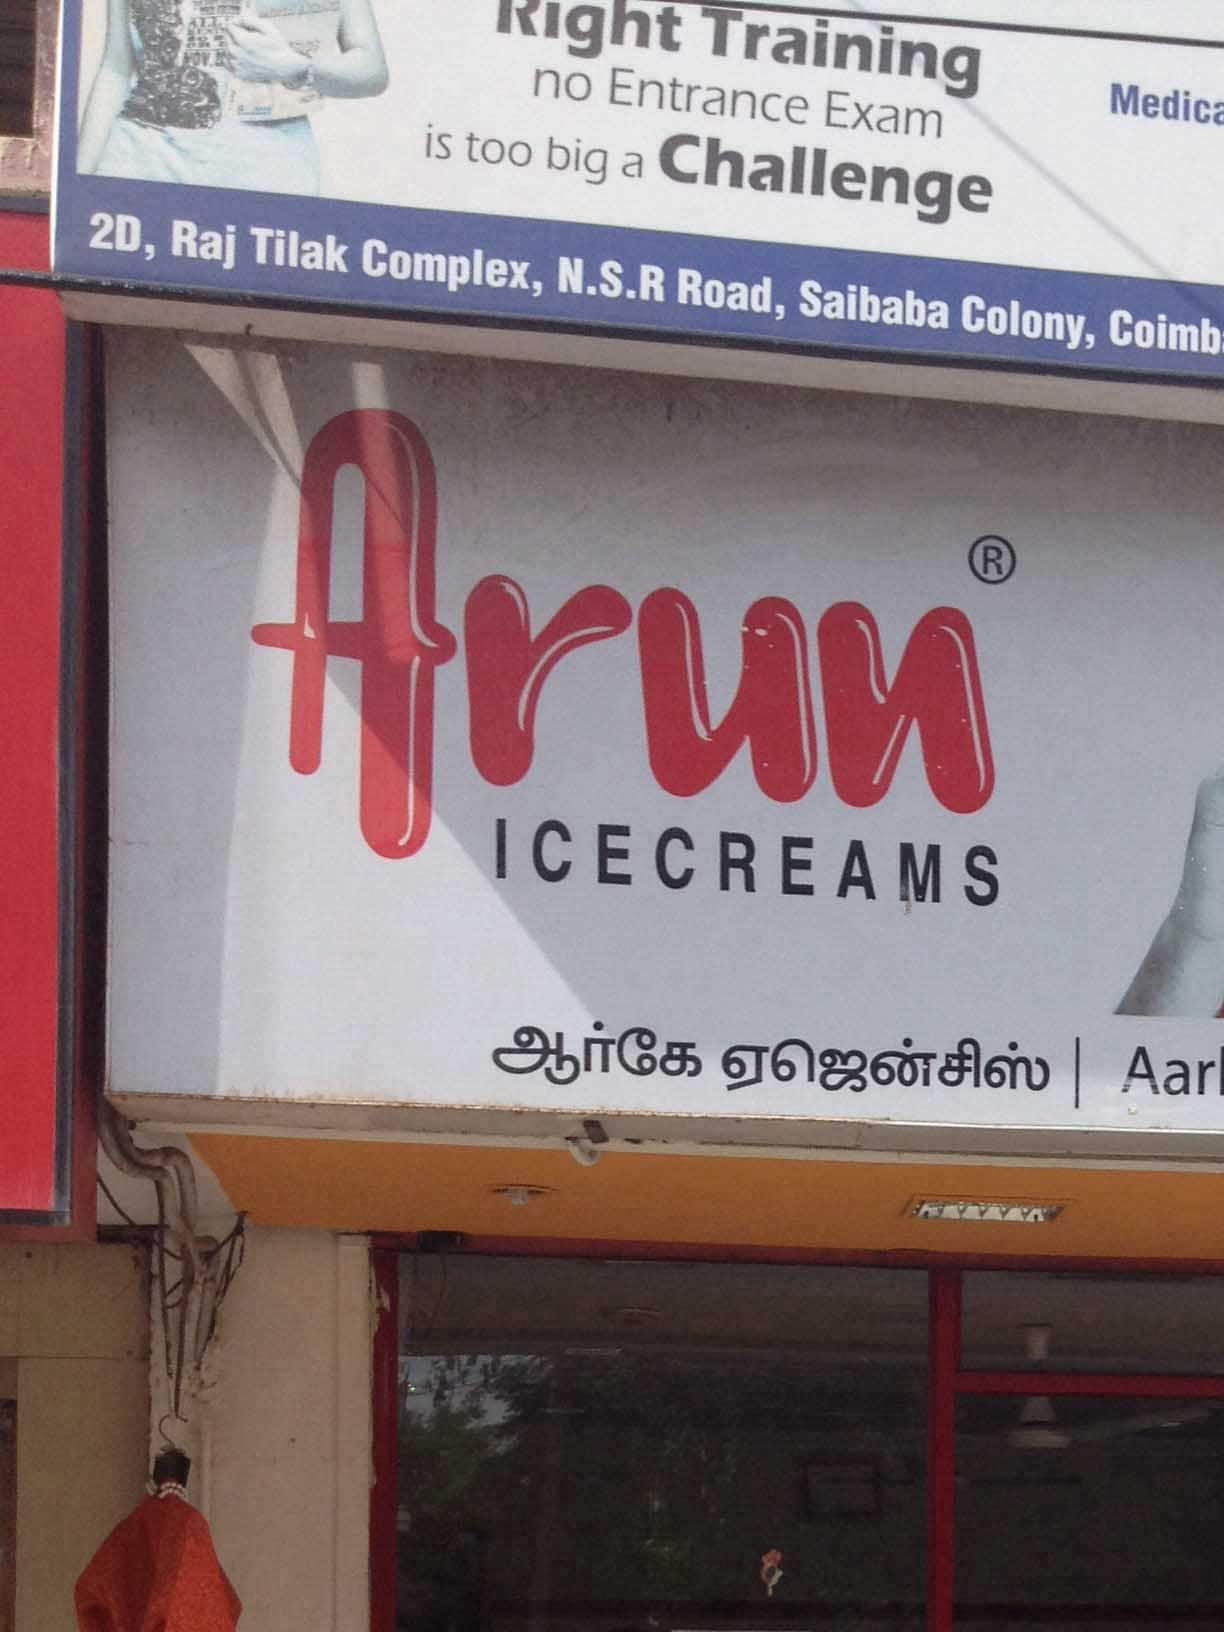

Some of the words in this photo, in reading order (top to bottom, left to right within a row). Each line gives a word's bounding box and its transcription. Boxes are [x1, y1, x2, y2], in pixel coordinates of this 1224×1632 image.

[497, 0, 682, 59] Right
[700, 7, 981, 98] Training
[533, 66, 591, 101] no
[609, 68, 808, 124] Entrance
[824, 91, 943, 138] Exam
[424, 123, 451, 160] is
[466, 130, 532, 167] too
[546, 137, 608, 184] big
[621, 149, 643, 178] a
[658, 133, 993, 225] Challenge
[89, 212, 156, 262] 2D,
[171, 219, 236, 270] Raj
[251, 226, 348, 274] Tilak
[362, 238, 543, 297] Complex,
[558, 256, 664, 302] N.S.R
[678, 267, 786, 321] Road,
[800, 279, 949, 330] Saibaba
[961, 294, 1096, 350] Colony,
[251, 408, 997, 860] Arun
[494, 817, 1001, 907] ICECREAMS
[492, 1020, 703, 1086] ஆர்கே
[721, 1036, 1051, 1093] ஏஜென்சிஸ்
